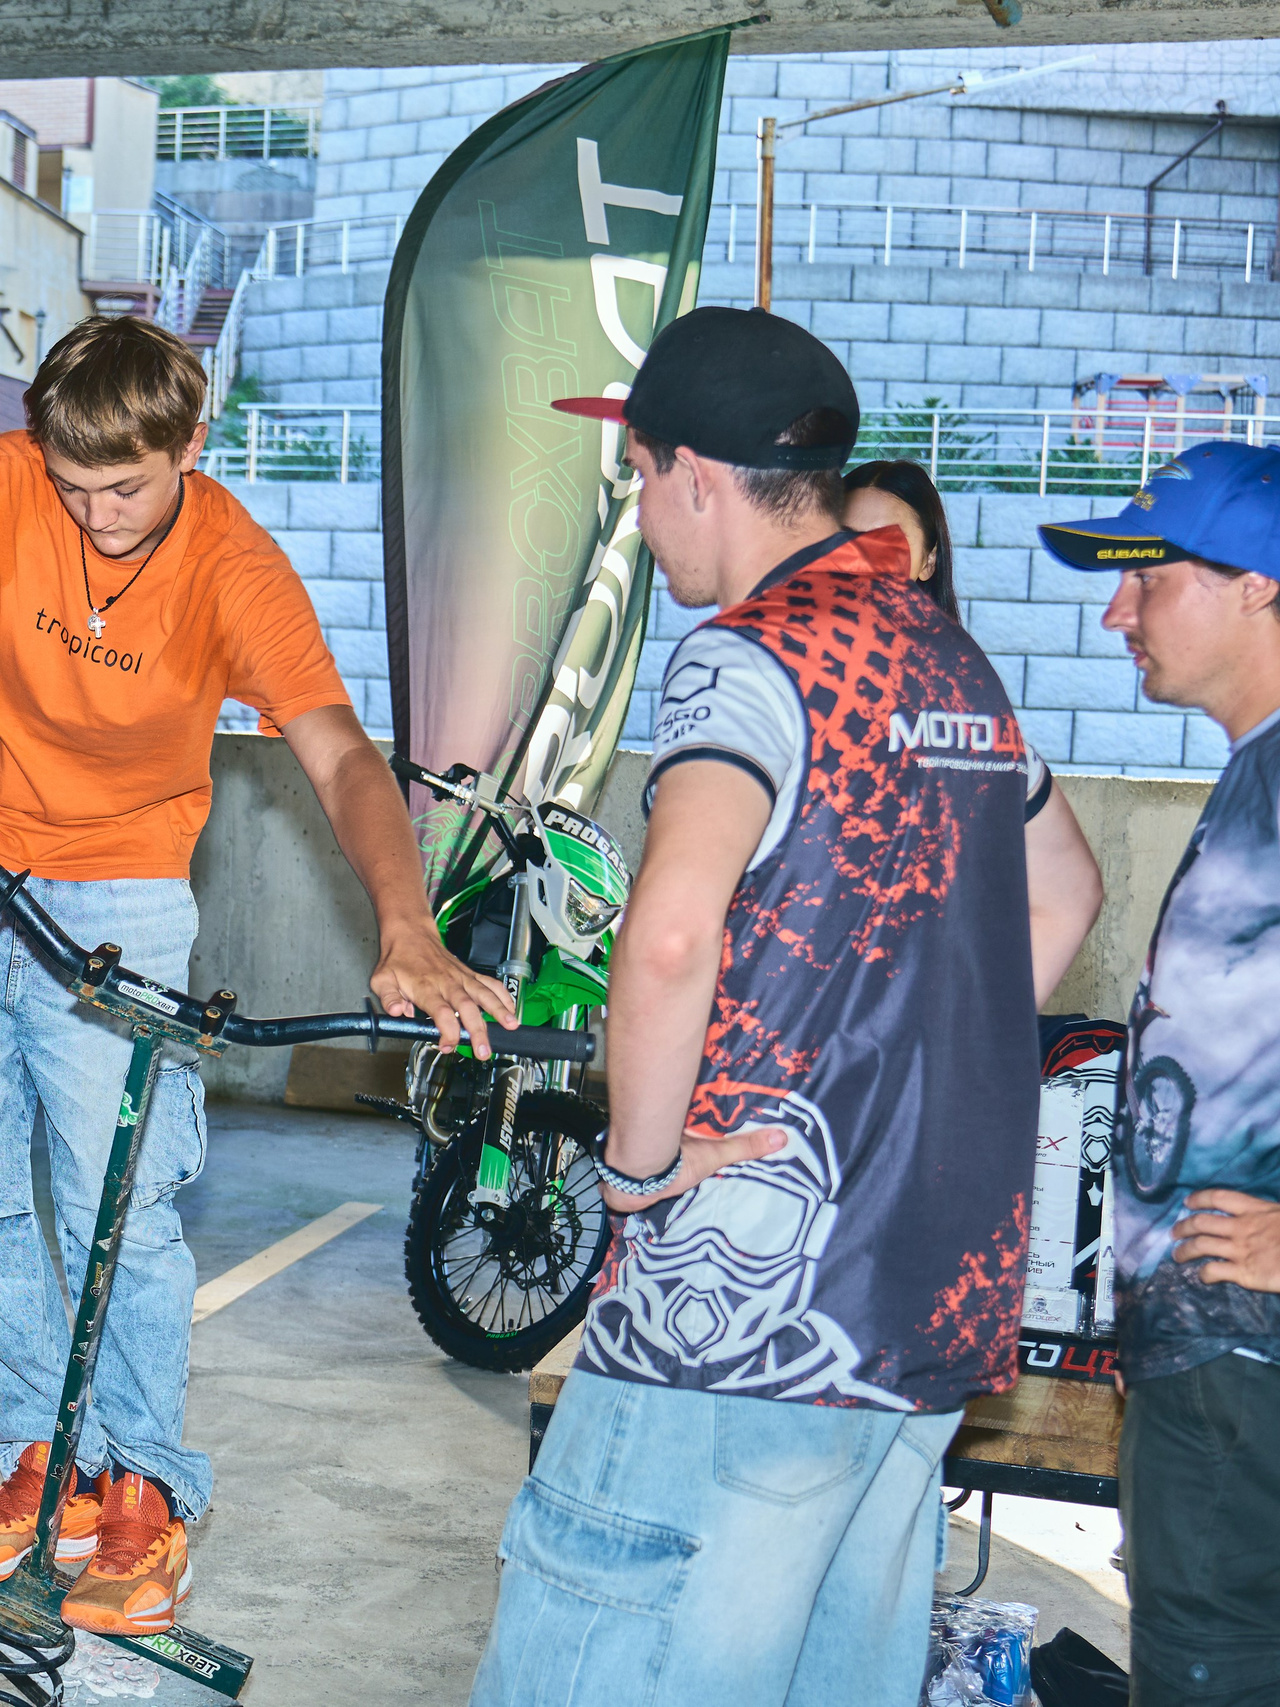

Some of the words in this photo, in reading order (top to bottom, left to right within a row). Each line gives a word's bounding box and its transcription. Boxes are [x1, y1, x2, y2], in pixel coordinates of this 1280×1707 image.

[1096, 547, 1165, 560] SUBARU
[36, 608, 143, 675] tropicool
[888, 710, 1027, 760] МОТОЦ
[499, 1076, 520, 1151] PROGASI
